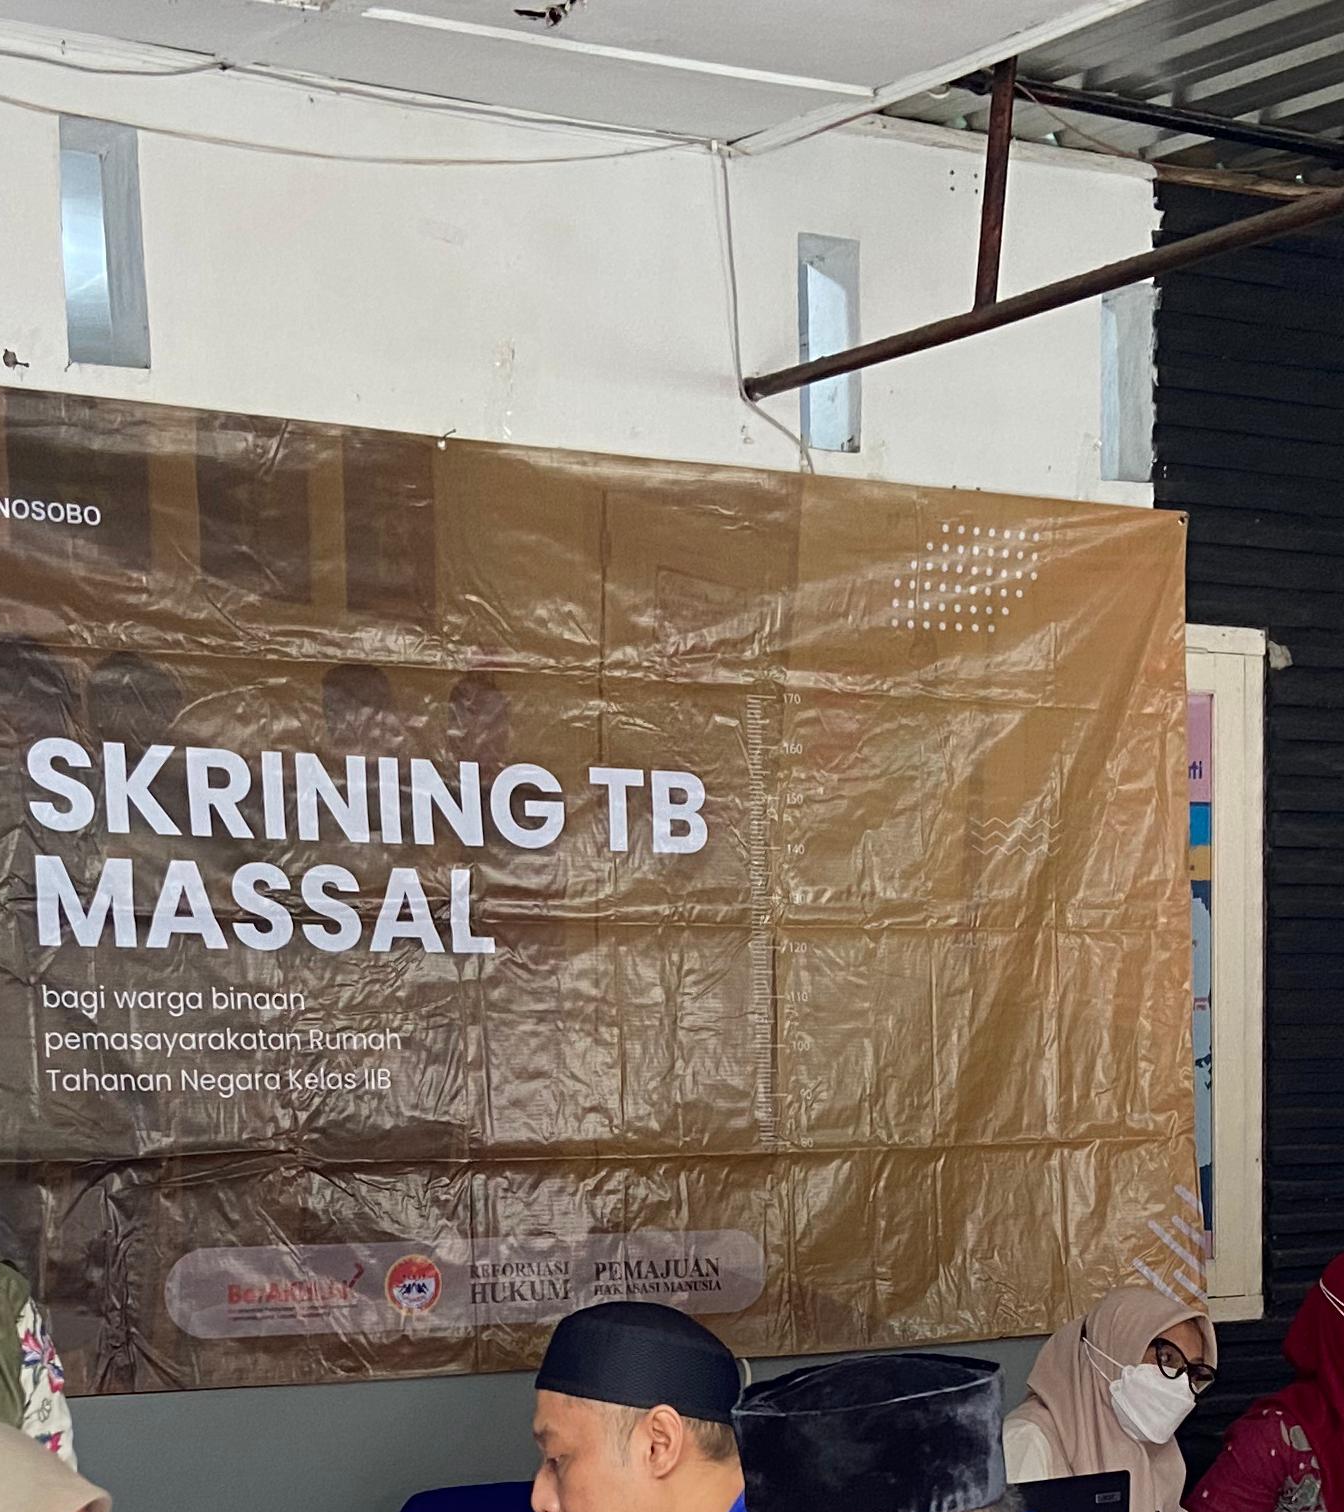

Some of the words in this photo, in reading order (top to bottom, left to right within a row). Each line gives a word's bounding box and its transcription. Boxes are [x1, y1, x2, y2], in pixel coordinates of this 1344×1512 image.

[26, 737, 565, 850] SKRINING
[589, 766, 709, 854] TB
[35, 854, 496, 955] MASSAL
[41, 984, 106, 1019] bagi
[113, 990, 203, 1017] warga
[211, 986, 306, 1011] binaan
[45, 1027, 301, 1058] pemasayarakatan
[309, 1028, 402, 1050] Rumah
[45, 1069, 172, 1093] Tahanan
[181, 1069, 282, 1099] Negara
[289, 1068, 357, 1091] Kelas
[364, 1069, 392, 1090] IIB
[469, 1260, 570, 1279] REFORMASI
[593, 1257, 721, 1282] PEMAJUAN
[470, 1279, 571, 1304] HUKUM
[594, 1281, 623, 1296] HAK
[663, 1279, 723, 1293] MANUSIA
